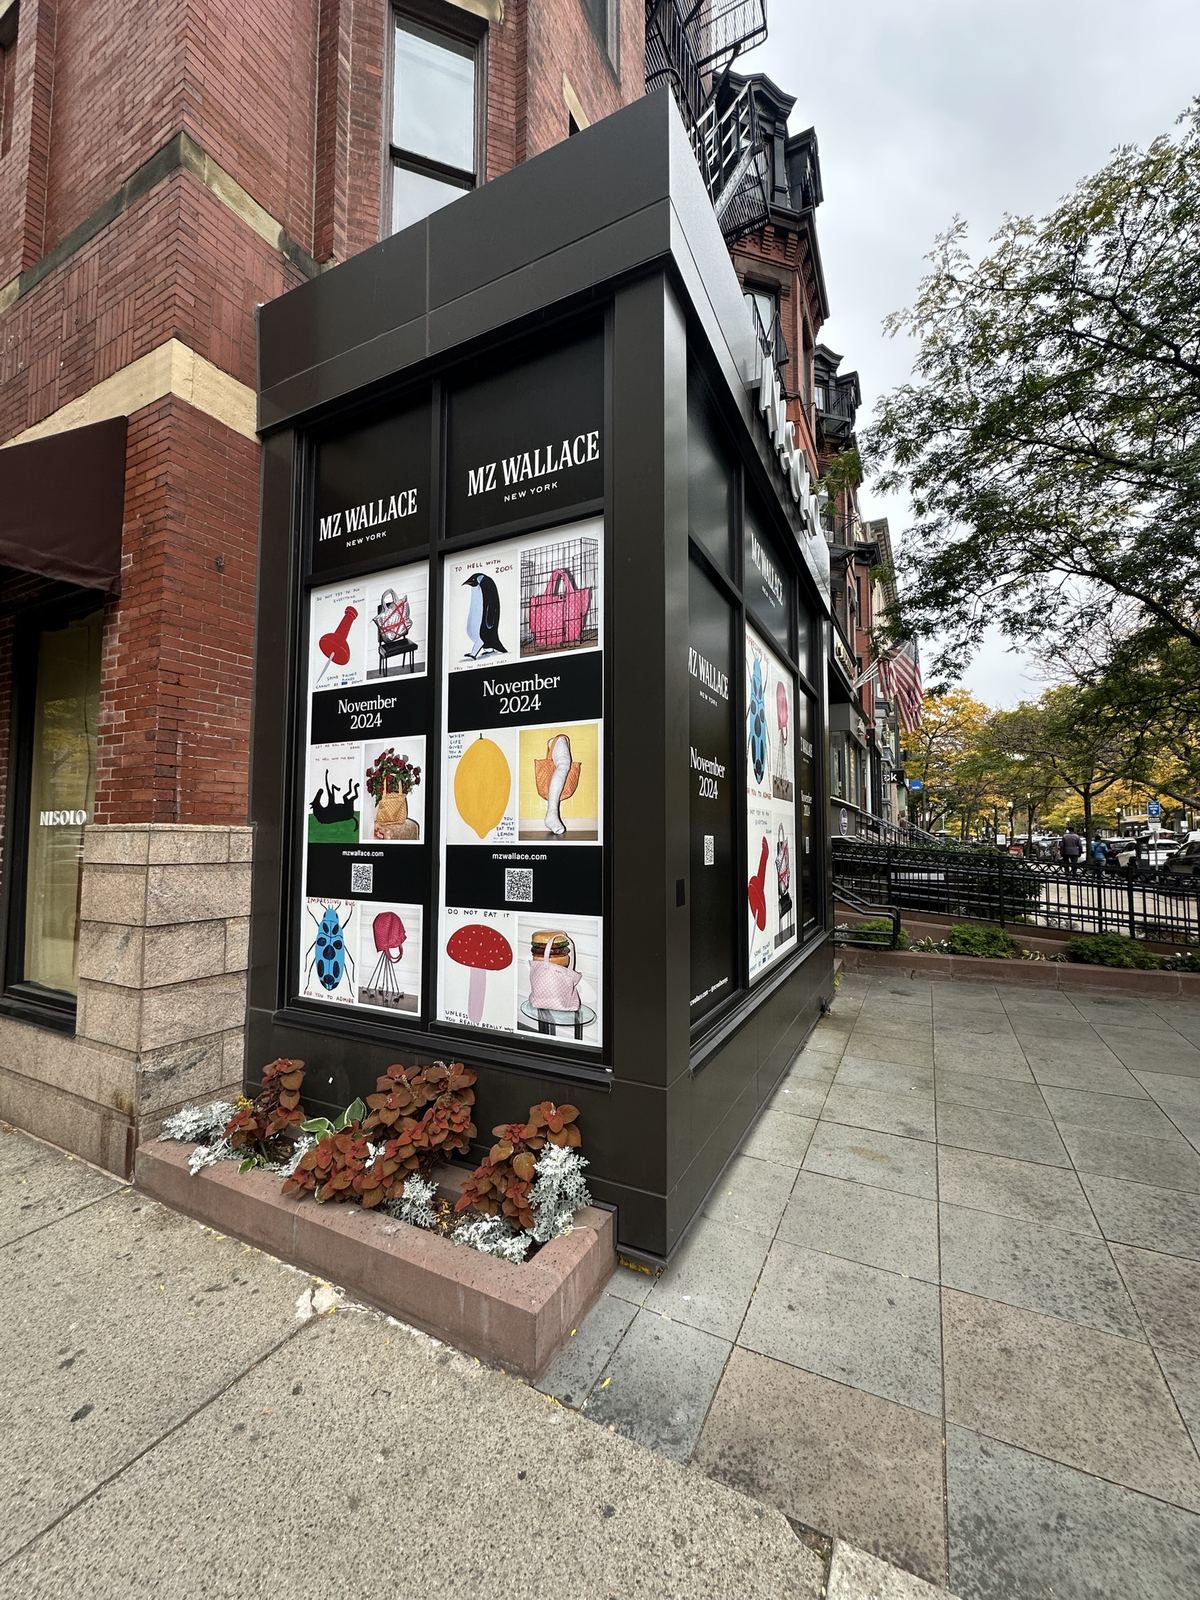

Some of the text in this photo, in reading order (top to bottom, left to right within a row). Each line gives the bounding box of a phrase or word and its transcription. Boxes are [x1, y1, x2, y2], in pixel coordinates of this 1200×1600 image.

[467, 430, 600, 497] MZ WALLACE
[503, 481, 558, 503] NEW YORK
[319, 488, 418, 542] MZ WALLACE
[346, 530, 387, 548] NEW YORK
[466, 562, 483, 570] HELL
[495, 565, 513, 574] ZOOS
[482, 673, 561, 697] November
[698, 654, 729, 701] WALLACE
[337, 694, 398, 715] November
[499, 693, 542, 715] 2024
[350, 712, 383, 730] 2024
[690, 746, 726, 779] November
[698, 775, 719, 800] 2024
[39, 809, 87, 826] NISOLO
[341, 849, 385, 857] mzwallace.com
[491, 852, 547, 861] mzwallace.com
[444, 1009, 469, 1019] UNLESS
[459, 1018, 480, 1027] REALLY
[481, 1022, 502, 1030] REALLY
